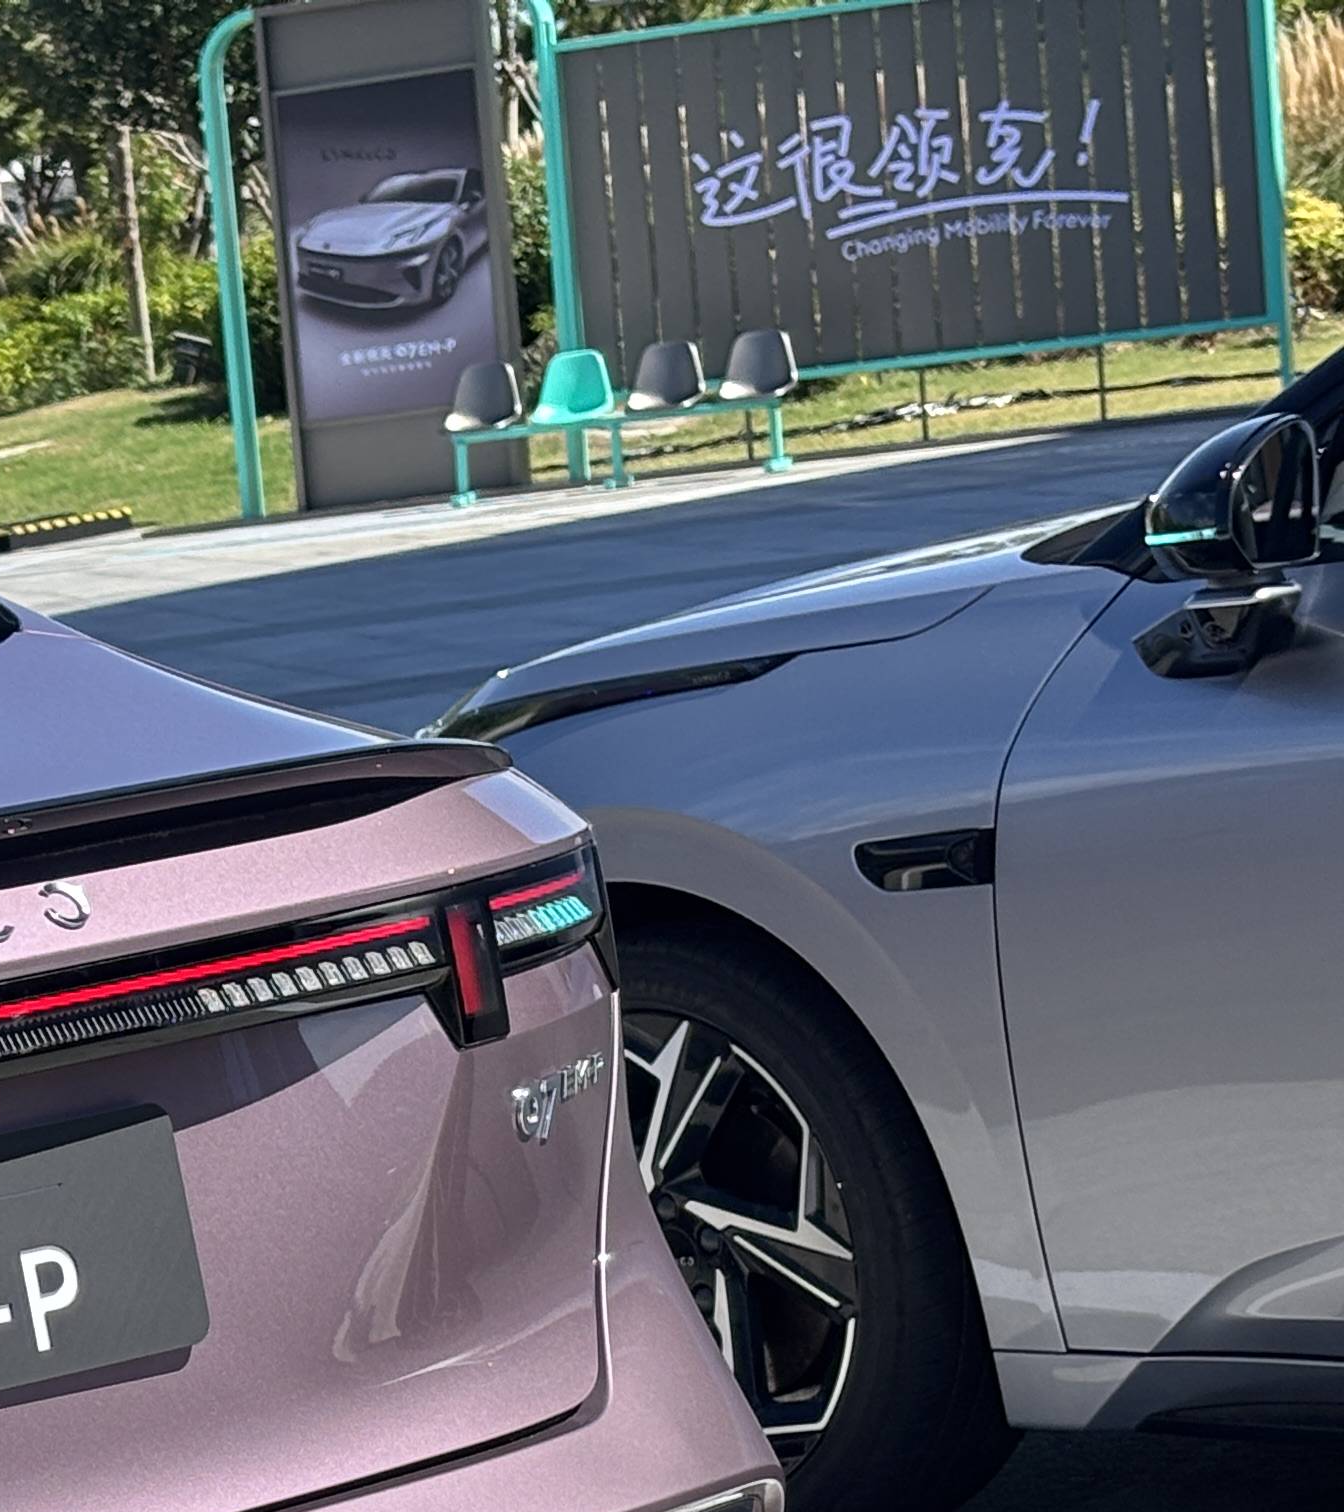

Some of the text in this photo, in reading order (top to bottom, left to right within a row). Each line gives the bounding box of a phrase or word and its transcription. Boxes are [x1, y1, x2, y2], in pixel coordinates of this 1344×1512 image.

[841, 208, 1111, 262] Changing Mobility Forever
